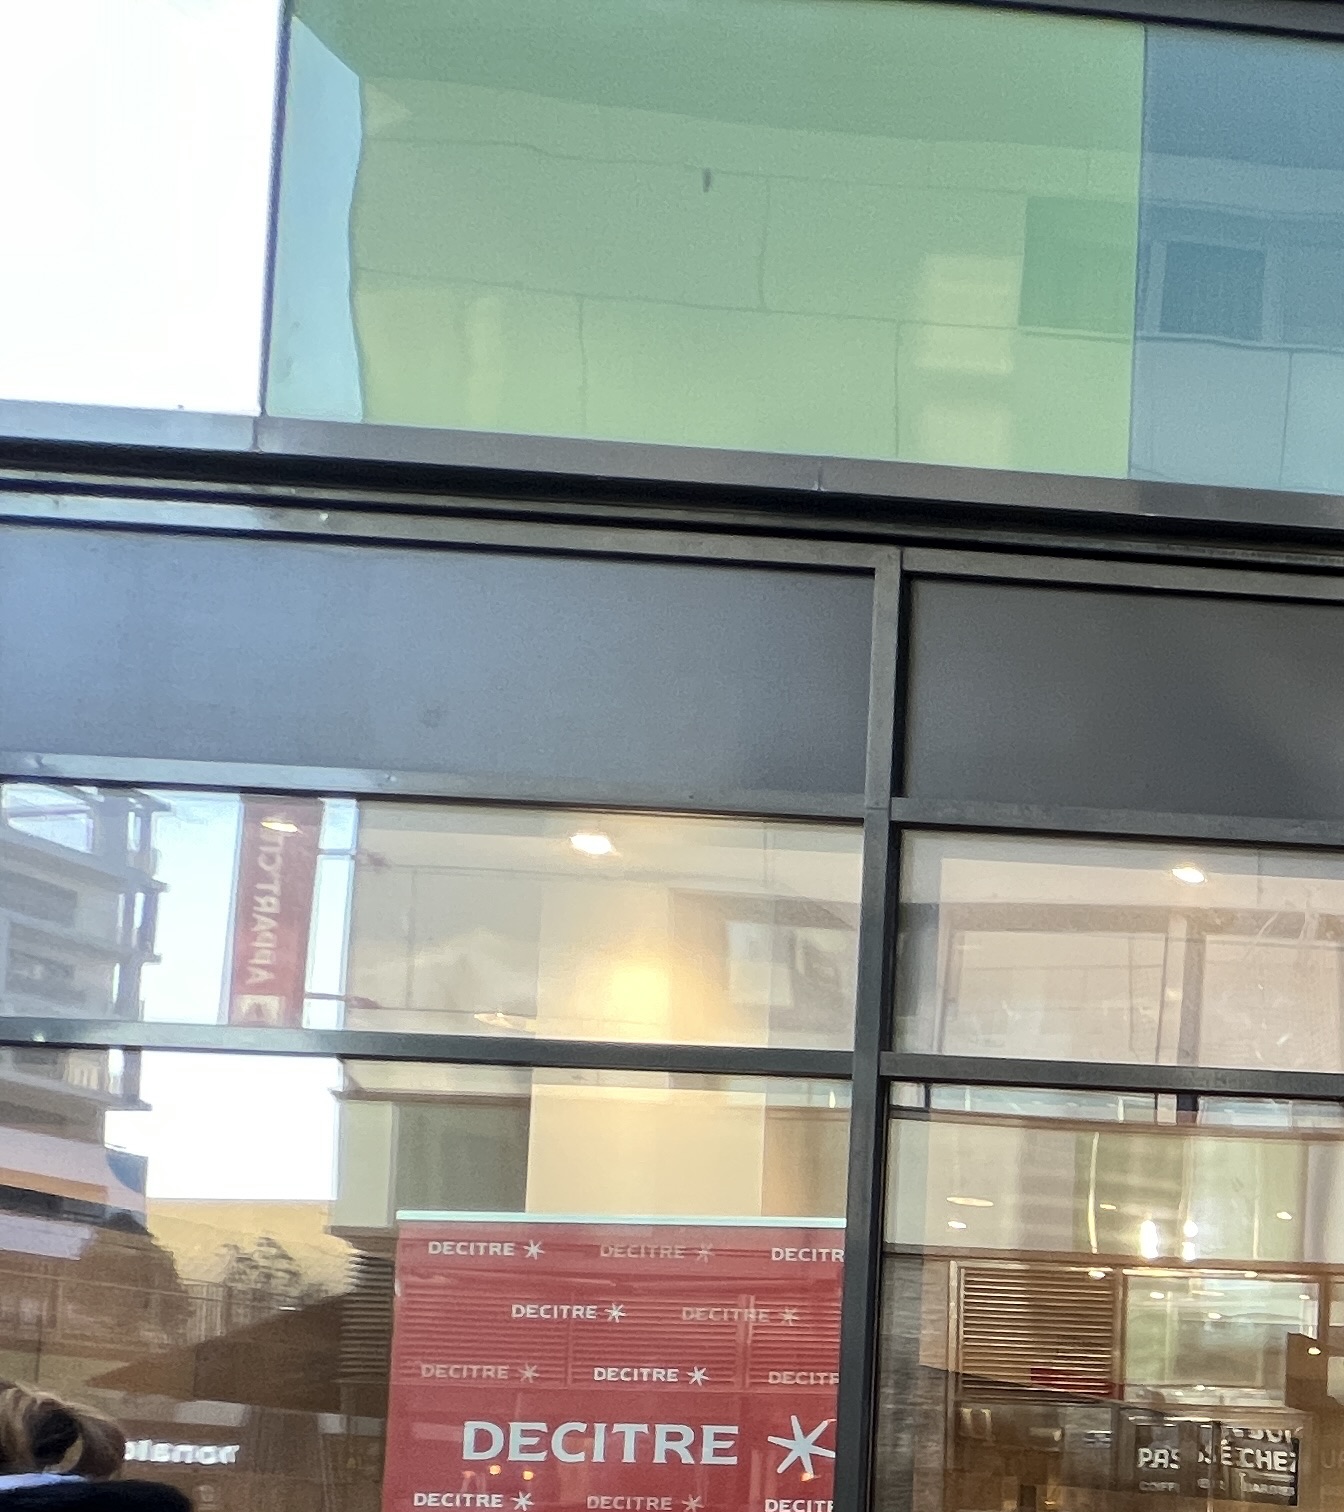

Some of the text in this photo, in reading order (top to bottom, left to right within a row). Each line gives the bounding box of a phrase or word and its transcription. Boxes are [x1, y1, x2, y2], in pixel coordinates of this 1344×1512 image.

[428, 1240, 515, 1257] DECITRE
[601, 1244, 685, 1259] DECITRE
[771, 1247, 845, 1262] DECITR
[512, 1304, 597, 1321] DECITRE
[682, 1307, 770, 1324] DECITRE
[420, 1363, 509, 1380] DECITRE
[593, 1367, 679, 1384] DECITRE
[462, 1419, 740, 1465] DECITRE
[413, 1492, 503, 1510] DECITRE
[587, 1495, 672, 1512] DECITRE
